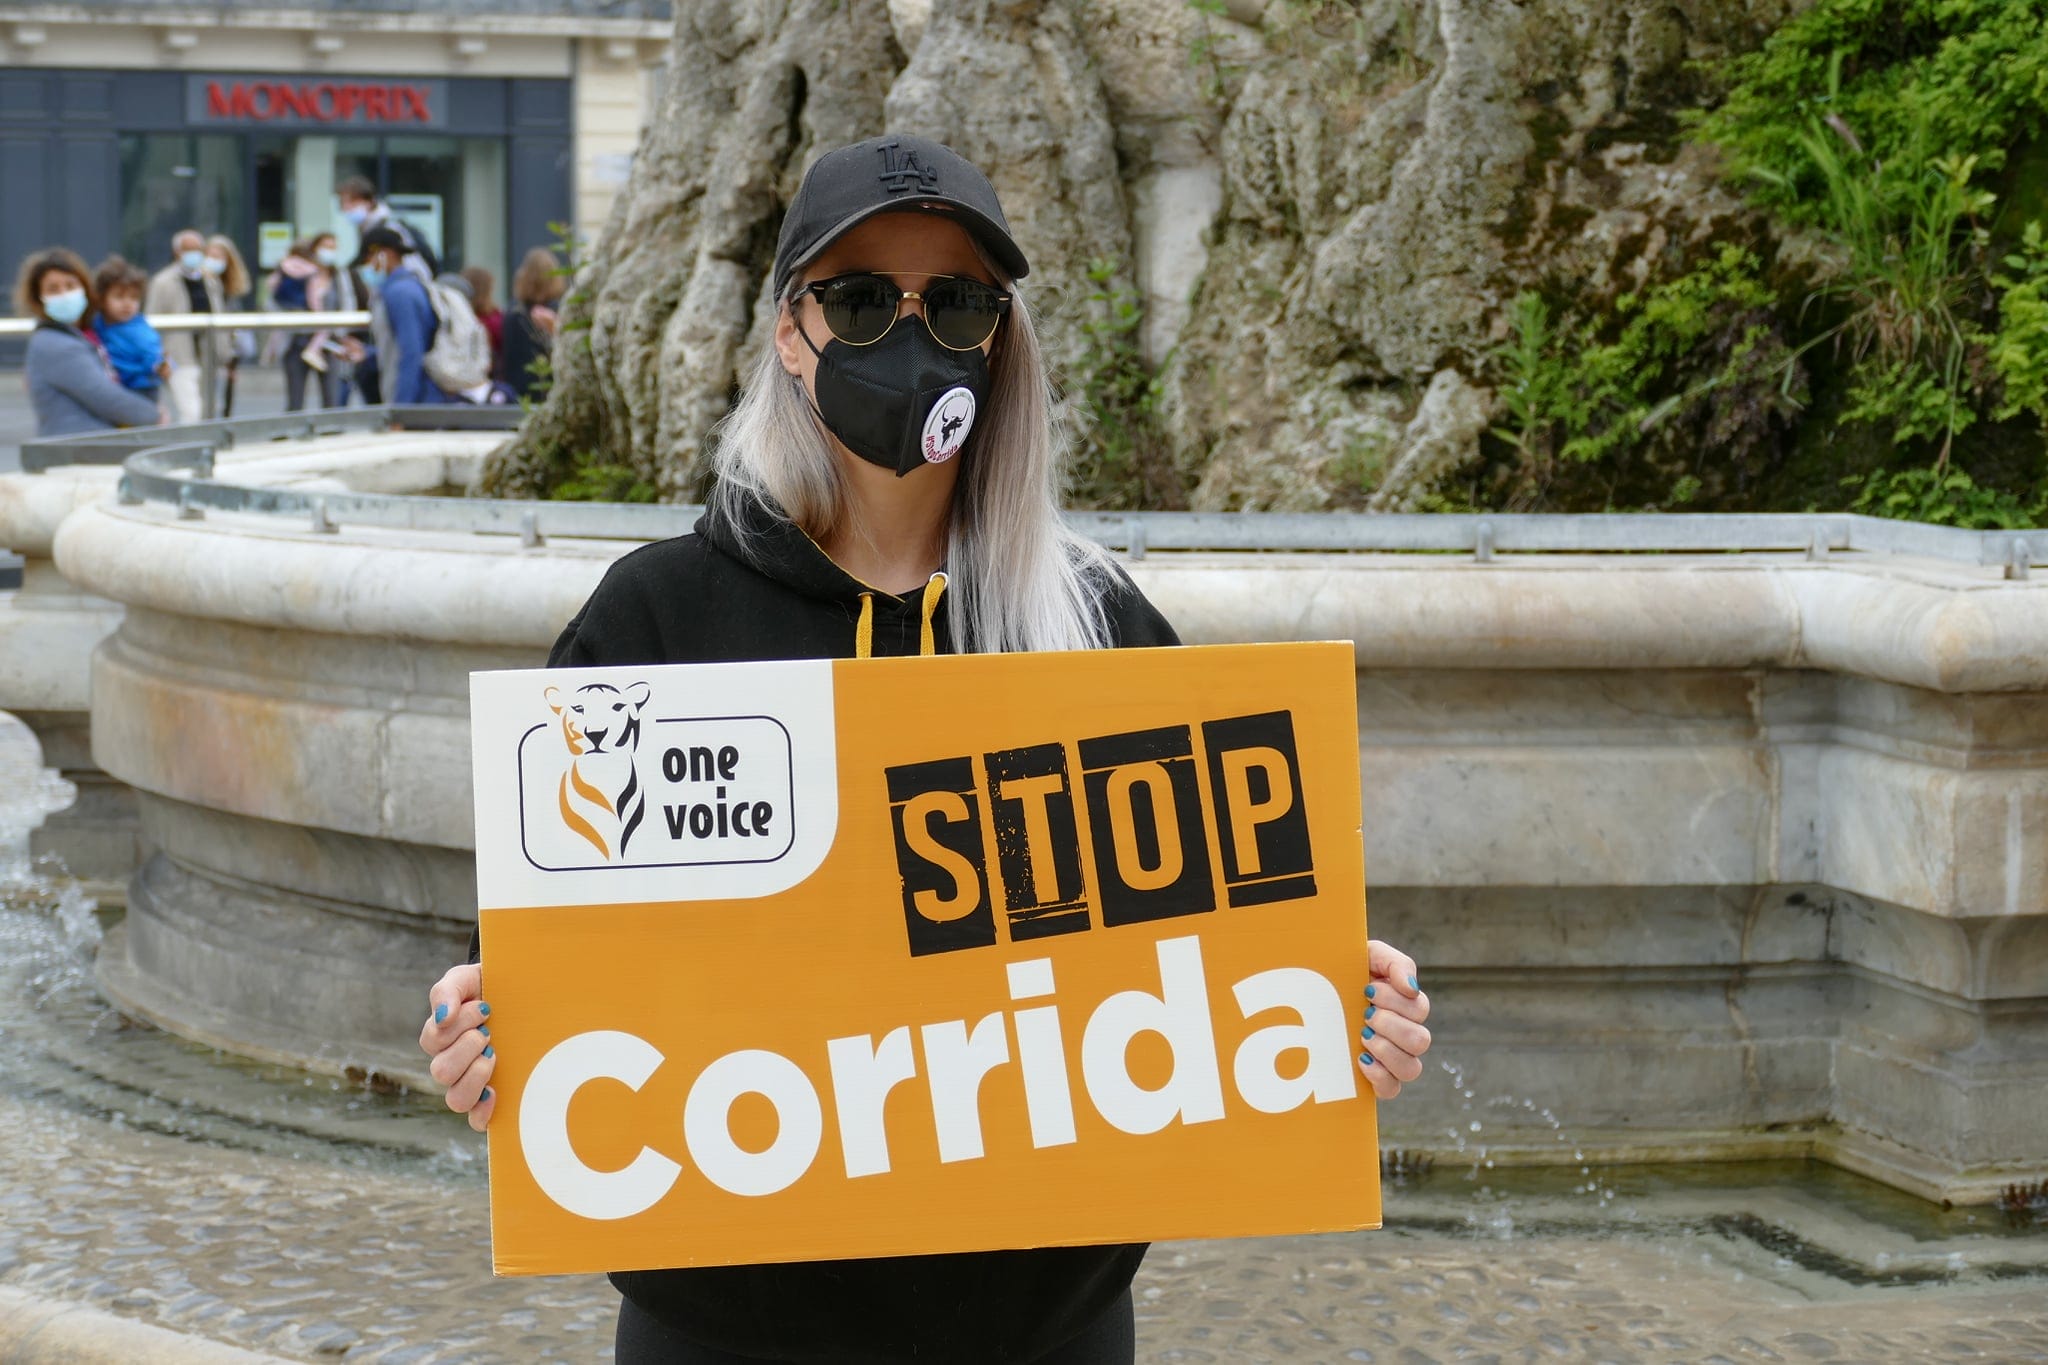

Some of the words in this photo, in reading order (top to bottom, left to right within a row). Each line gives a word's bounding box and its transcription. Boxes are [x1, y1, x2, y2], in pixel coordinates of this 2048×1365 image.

[206, 81, 431, 122] MONOPRIX
[877, 142, 940, 195] LA
[662, 744, 739, 783] one
[663, 785, 773, 840] voice
[899, 744, 1295, 924] STOP
[518, 934, 1358, 1220] Corrida
